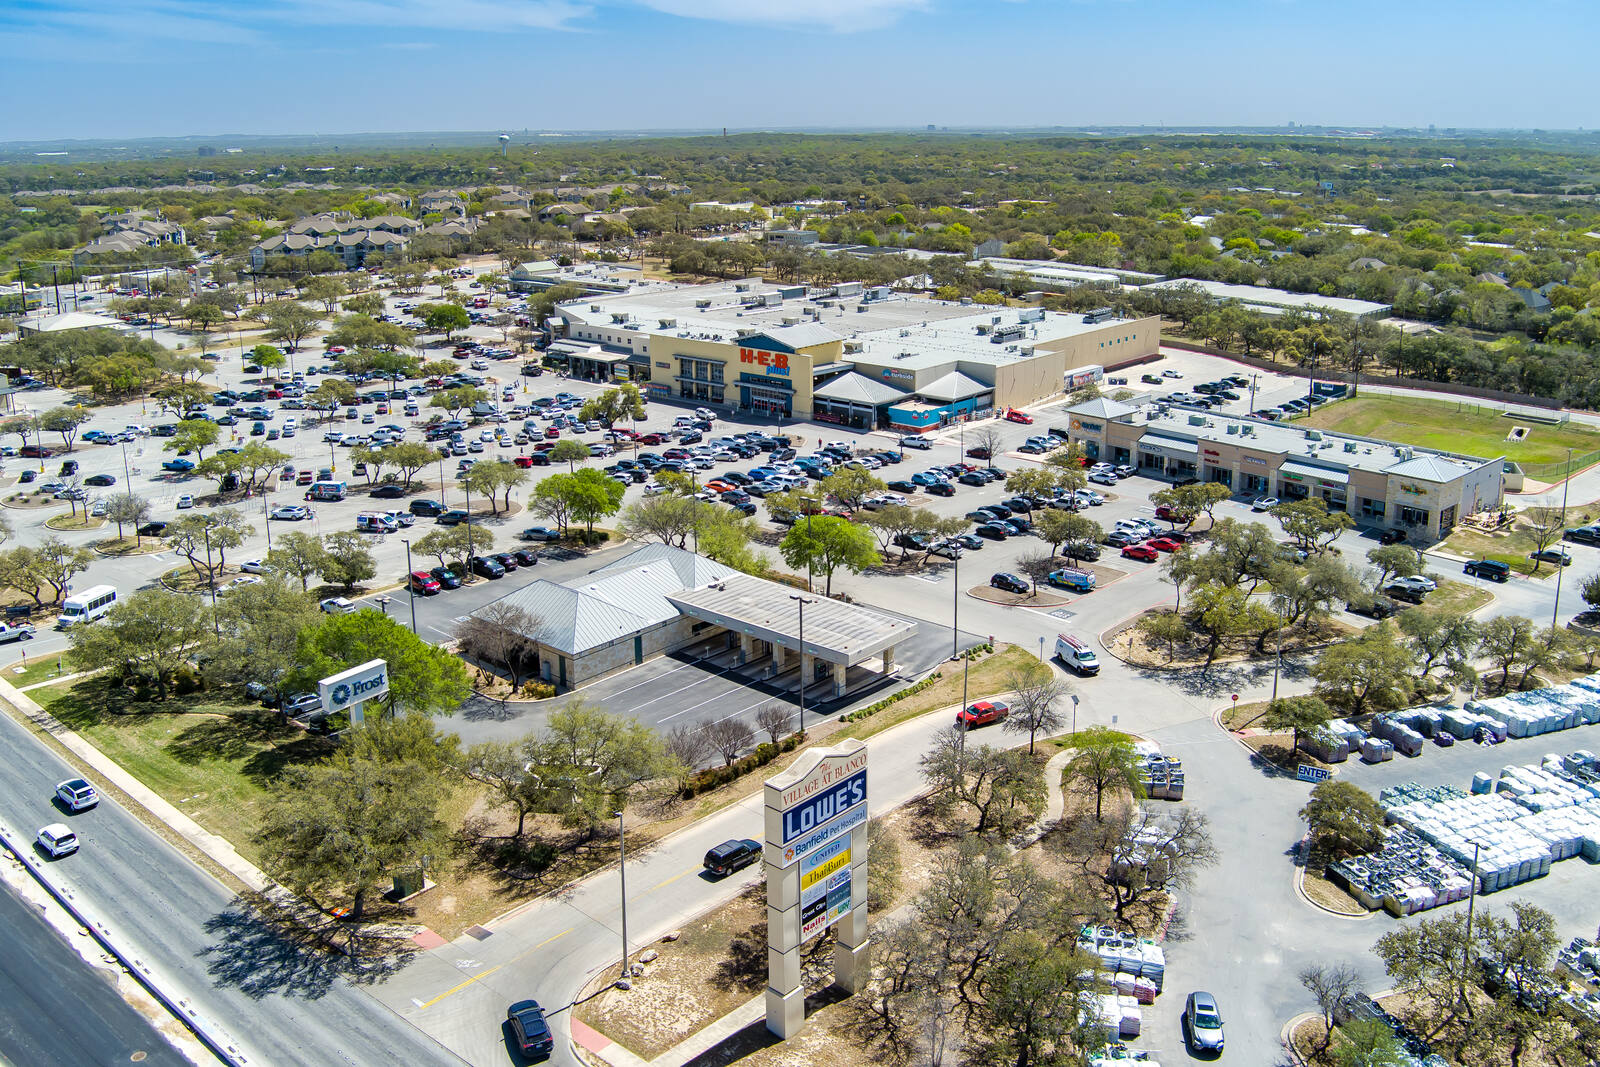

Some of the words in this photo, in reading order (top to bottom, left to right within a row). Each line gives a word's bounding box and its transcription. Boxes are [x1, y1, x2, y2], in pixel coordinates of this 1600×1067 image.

[352, 673, 386, 697] Frost
[783, 779, 819, 805] VILLAGE
[822, 772, 832, 786] AT
[835, 754, 867, 778] BLANCO
[1298, 765, 1328, 780] ENTER
[787, 779, 863, 840] LOWE'S
[796, 830, 829, 855] Banfield
[830, 826, 840, 836] Pet
[840, 810, 865, 830] Hospital
[802, 914, 826, 934] Nails
